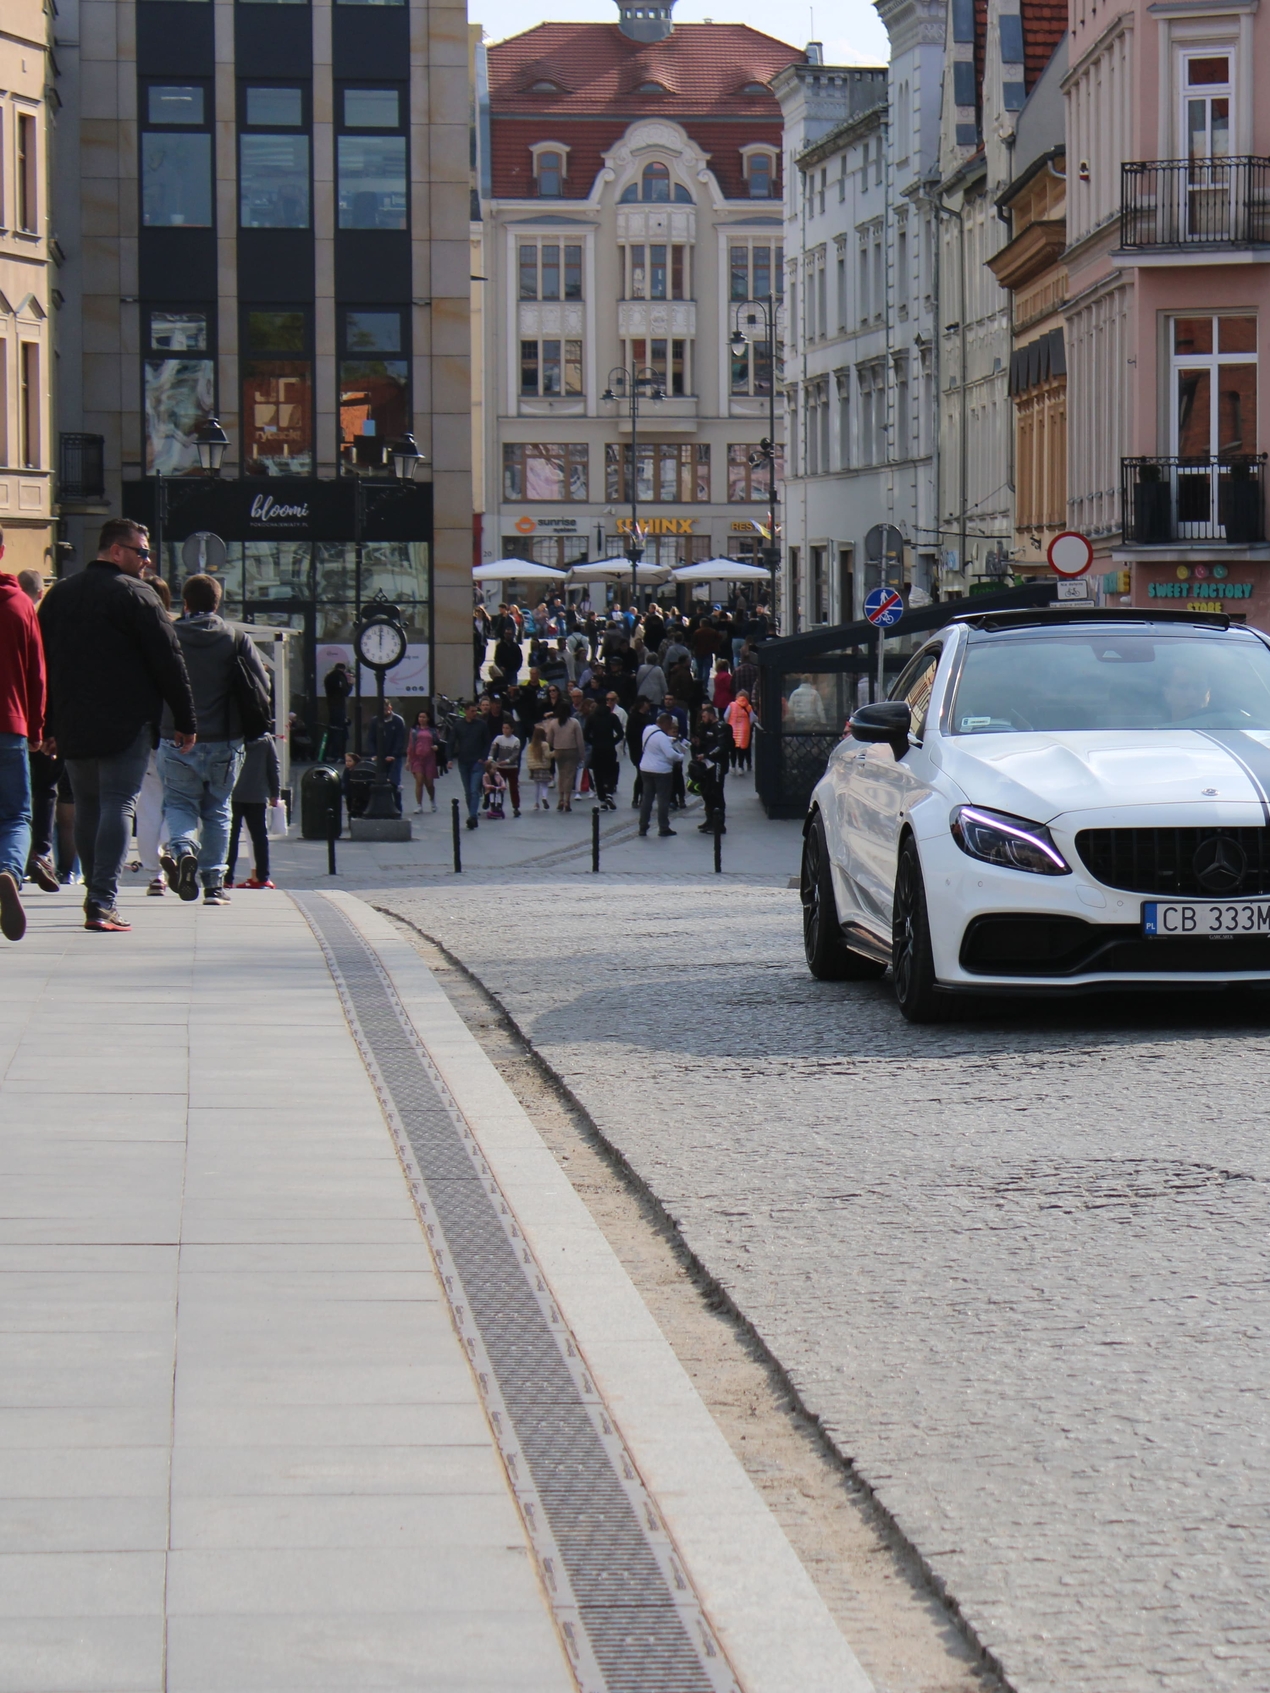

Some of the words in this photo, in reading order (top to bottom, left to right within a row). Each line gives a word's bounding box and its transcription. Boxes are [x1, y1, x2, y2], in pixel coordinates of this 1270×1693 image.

[250, 494, 309, 521] bloomi
[537, 517, 577, 526] sunrise
[616, 518, 694, 534] SPHINX
[1148, 583, 1189, 598] SWEET
[1193, 583, 1252, 599] FACTORY
[1187, 602, 1222, 613] STORE
[1146, 922, 1156, 930] PL
[1163, 906, 1197, 932] CB
